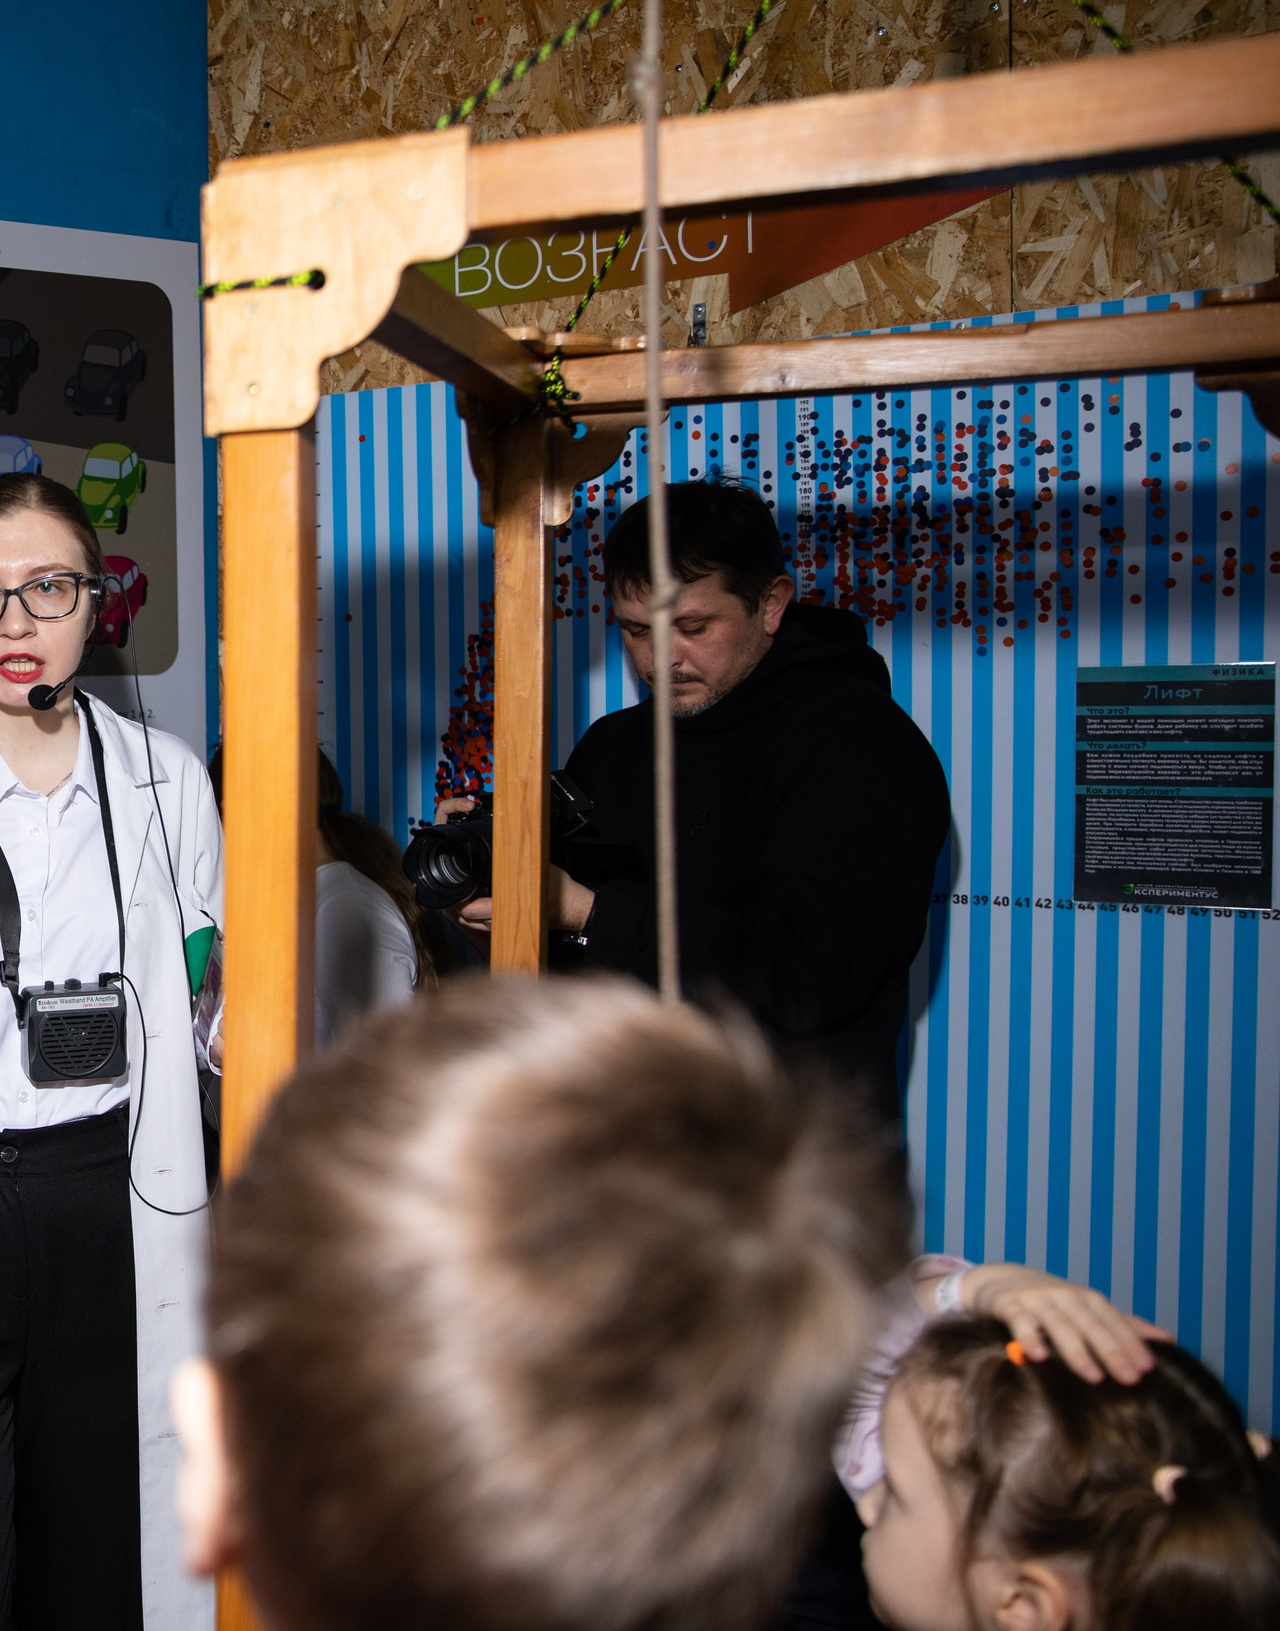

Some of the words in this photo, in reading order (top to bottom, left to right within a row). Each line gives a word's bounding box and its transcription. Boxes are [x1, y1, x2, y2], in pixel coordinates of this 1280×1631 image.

[1212, 668, 1264, 676] ФИЗИКА
[1143, 685, 1204, 700] Лифт
[1106, 742, 1146, 750] делать?
[1126, 788, 1181, 796] работает?
[1124, 883, 1218, 898] ЭКСПЕРИМЕНТУС
[952, 894, 968, 904] 38
[972, 895, 989, 906] 39
[993, 896, 1010, 907] 40
[1014, 897, 1030, 908] 41
[1035, 898, 1052, 909] 42
[1056, 899, 1073, 910] 43
[1099, 903, 1117, 912] 45
[1122, 903, 1139, 913] 46
[1144, 904, 1162, 914] 47
[1167, 905, 1185, 916] 48
[1190, 906, 1208, 917] 49
[1214, 908, 1232, 918] 50
[1238, 909, 1256, 919] 51
[1262, 910, 1280, 921] 52
